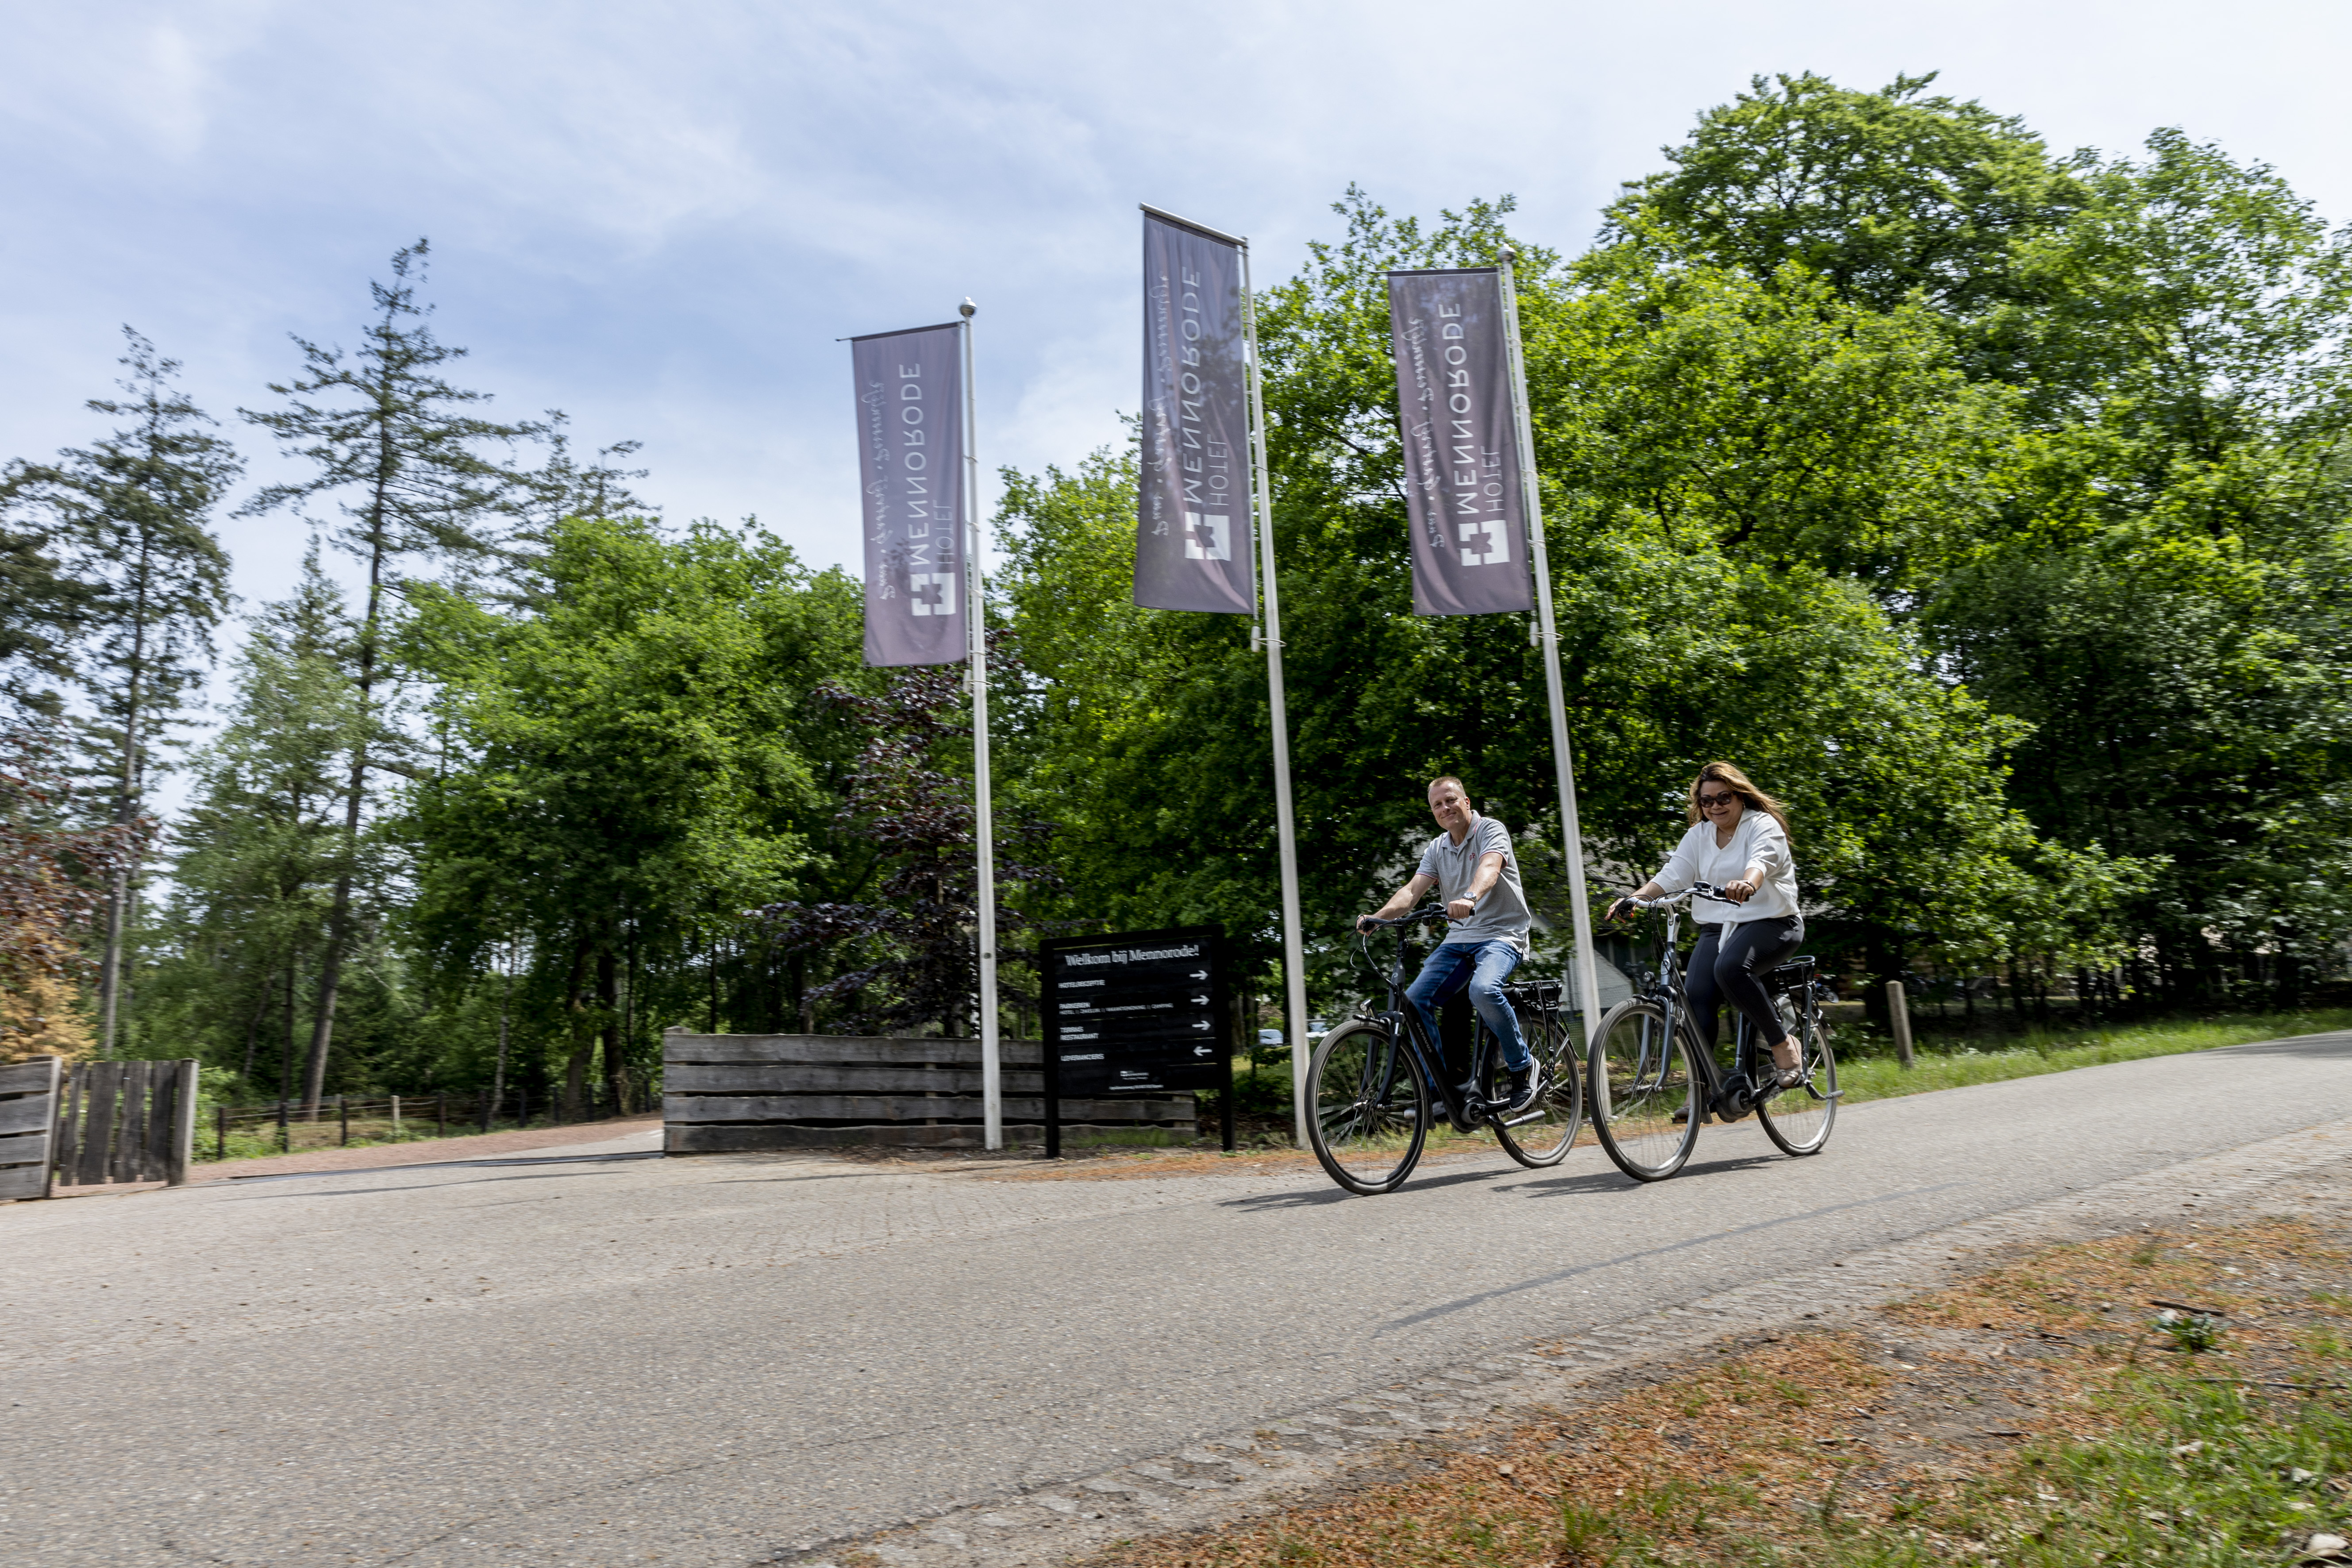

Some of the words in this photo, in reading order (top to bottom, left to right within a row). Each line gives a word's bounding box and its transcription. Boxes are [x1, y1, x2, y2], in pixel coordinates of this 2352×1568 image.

[1065, 953, 1111, 966] Welkom
[1111, 950, 1128, 964] bij
[1128, 944, 1199, 961] Mennorode!
[1416, 1022, 1432, 1053] BATAVUS
